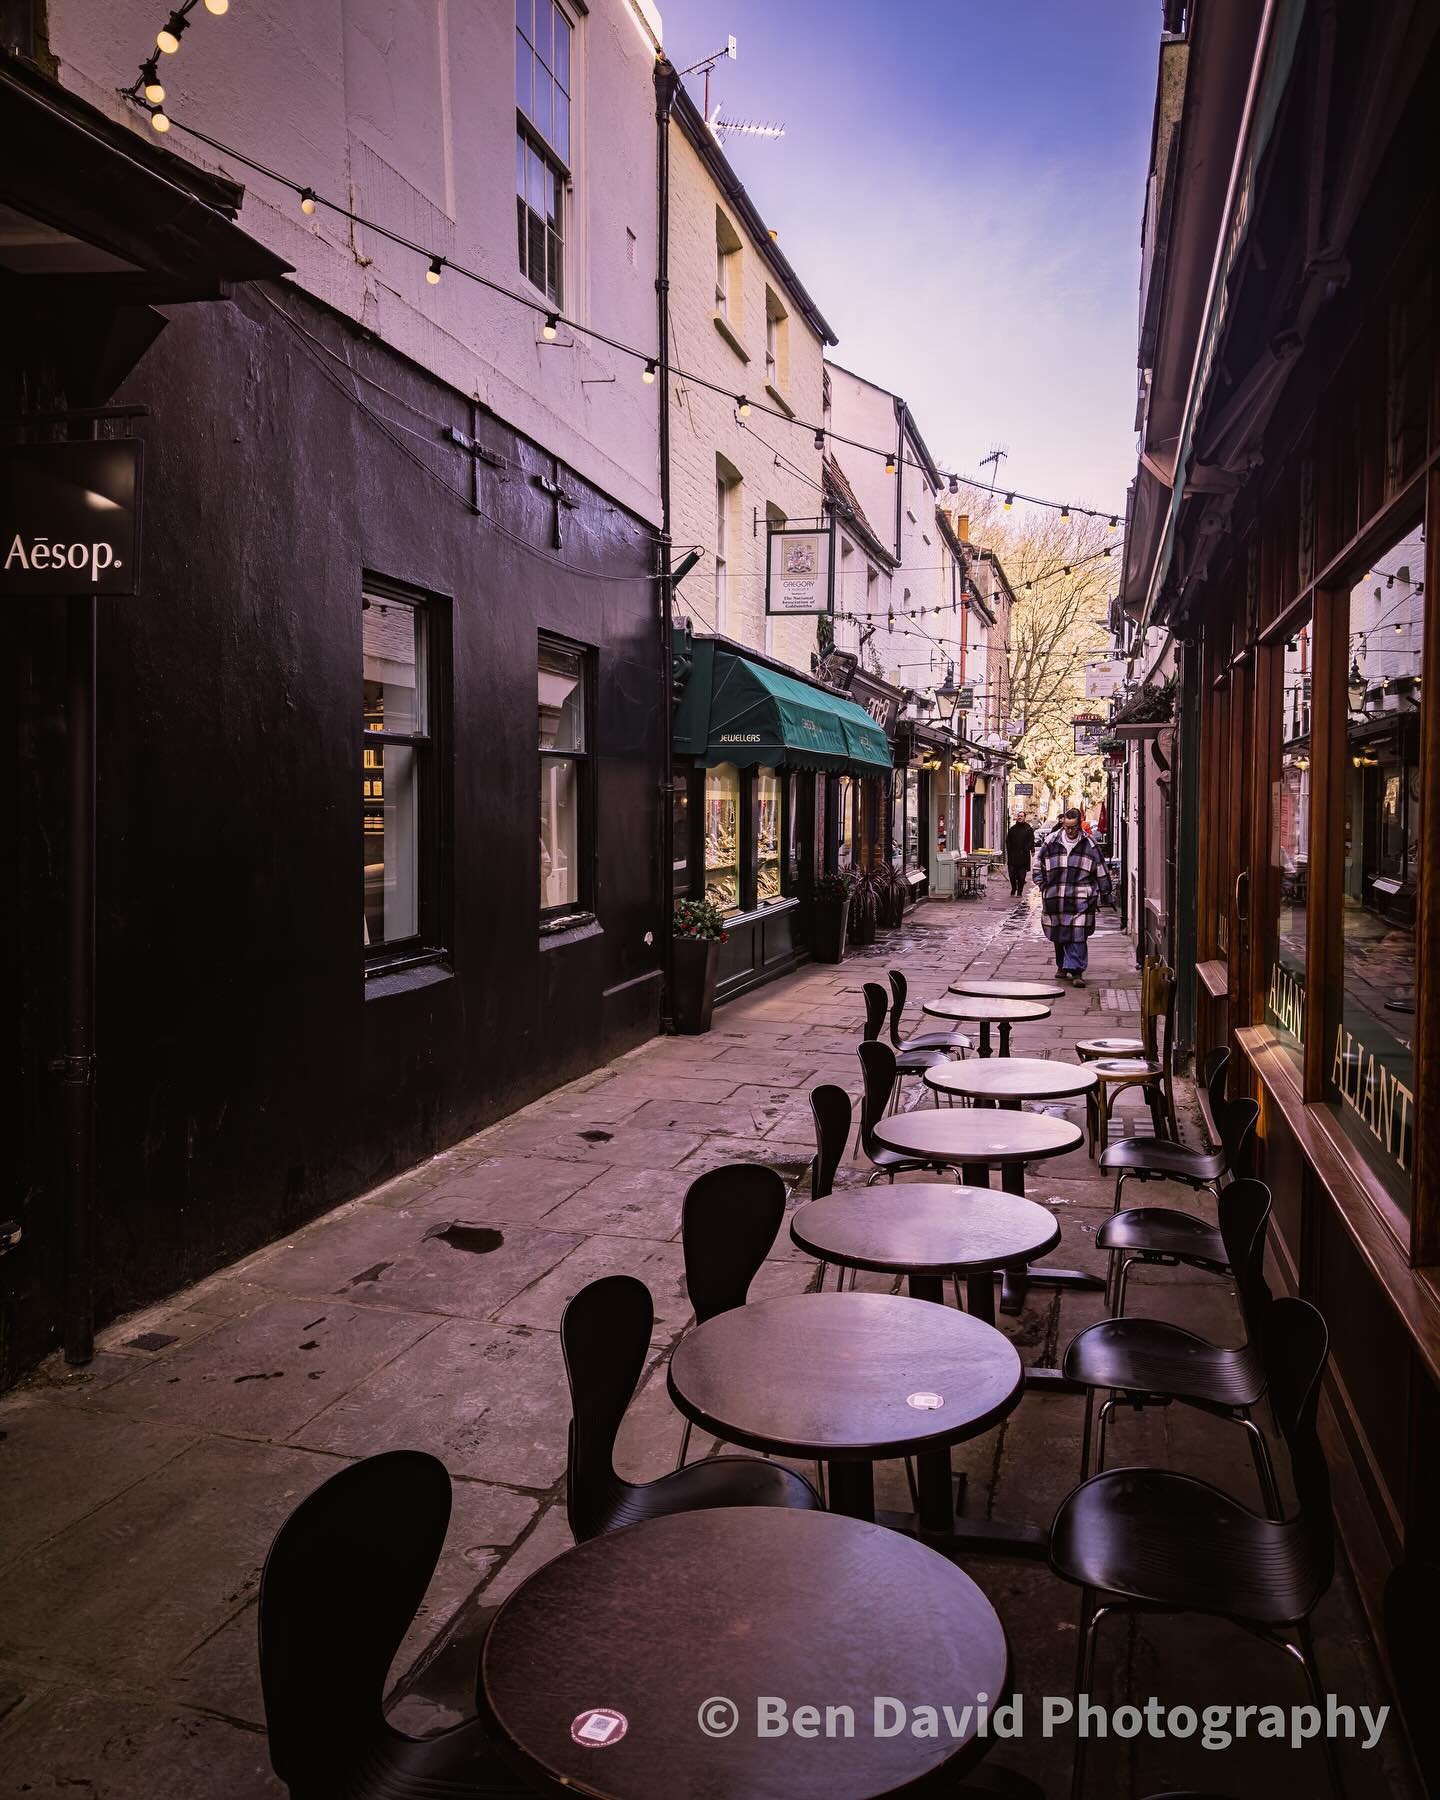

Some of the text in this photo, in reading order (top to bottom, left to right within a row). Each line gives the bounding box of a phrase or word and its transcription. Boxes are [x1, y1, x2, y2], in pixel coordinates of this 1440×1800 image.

[3, 534, 123, 582] Aēsop.
[719, 734, 761, 743] JEWELLERS
[1268, 962, 1306, 1044] ALIAN
